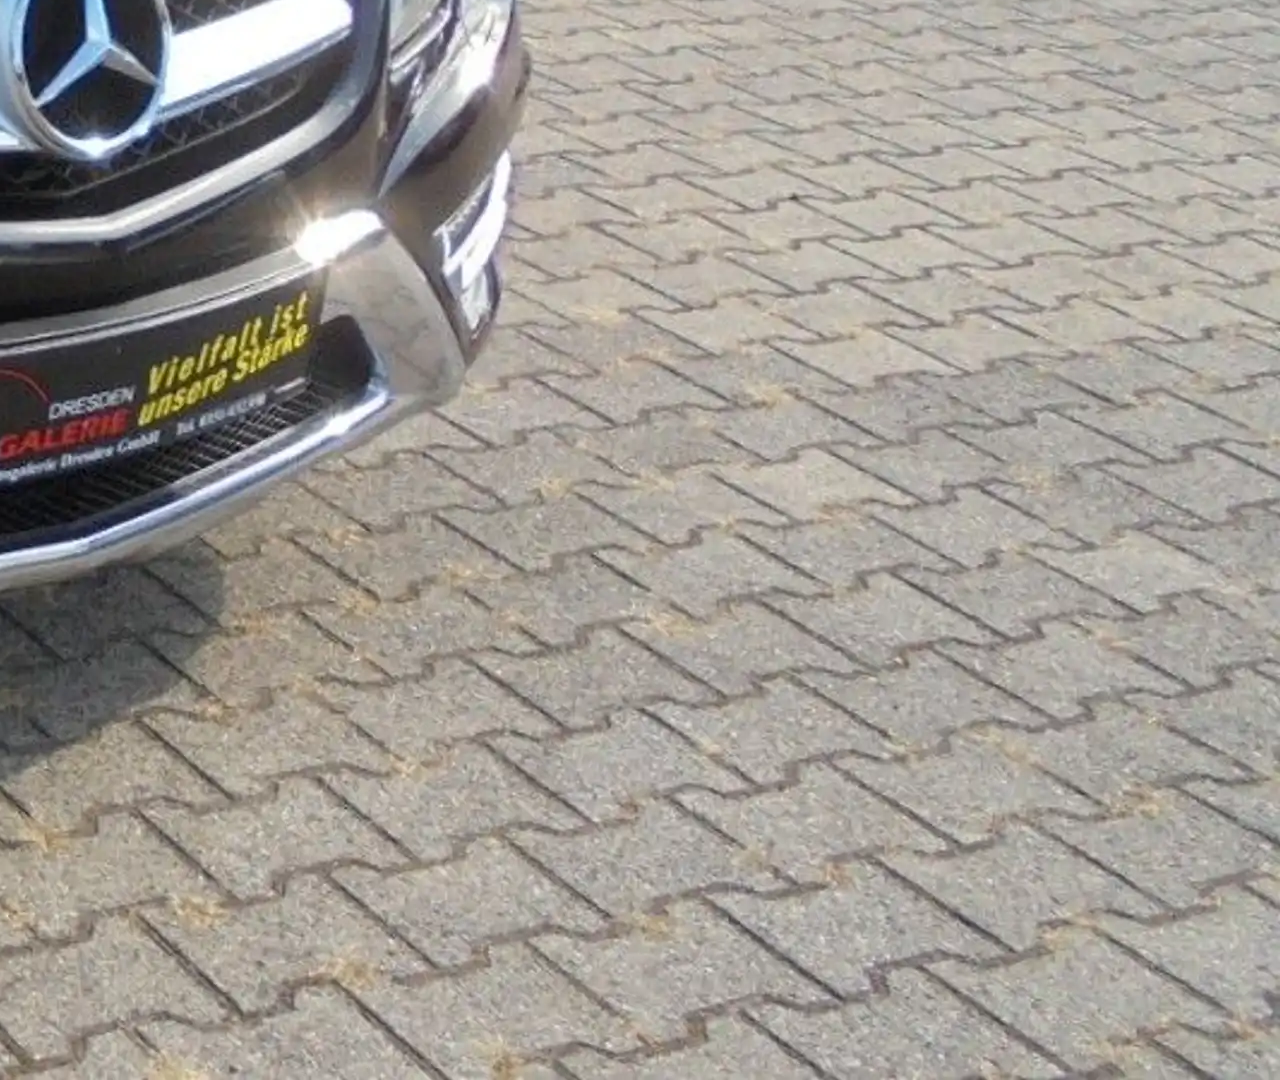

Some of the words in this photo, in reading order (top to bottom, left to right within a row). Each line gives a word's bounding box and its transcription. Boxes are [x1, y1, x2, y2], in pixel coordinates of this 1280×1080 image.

[149, 316, 262, 395] Vielfalt
[270, 291, 308, 339] ist
[48, 386, 136, 420] DRESDEN
[137, 367, 228, 427] unsere
